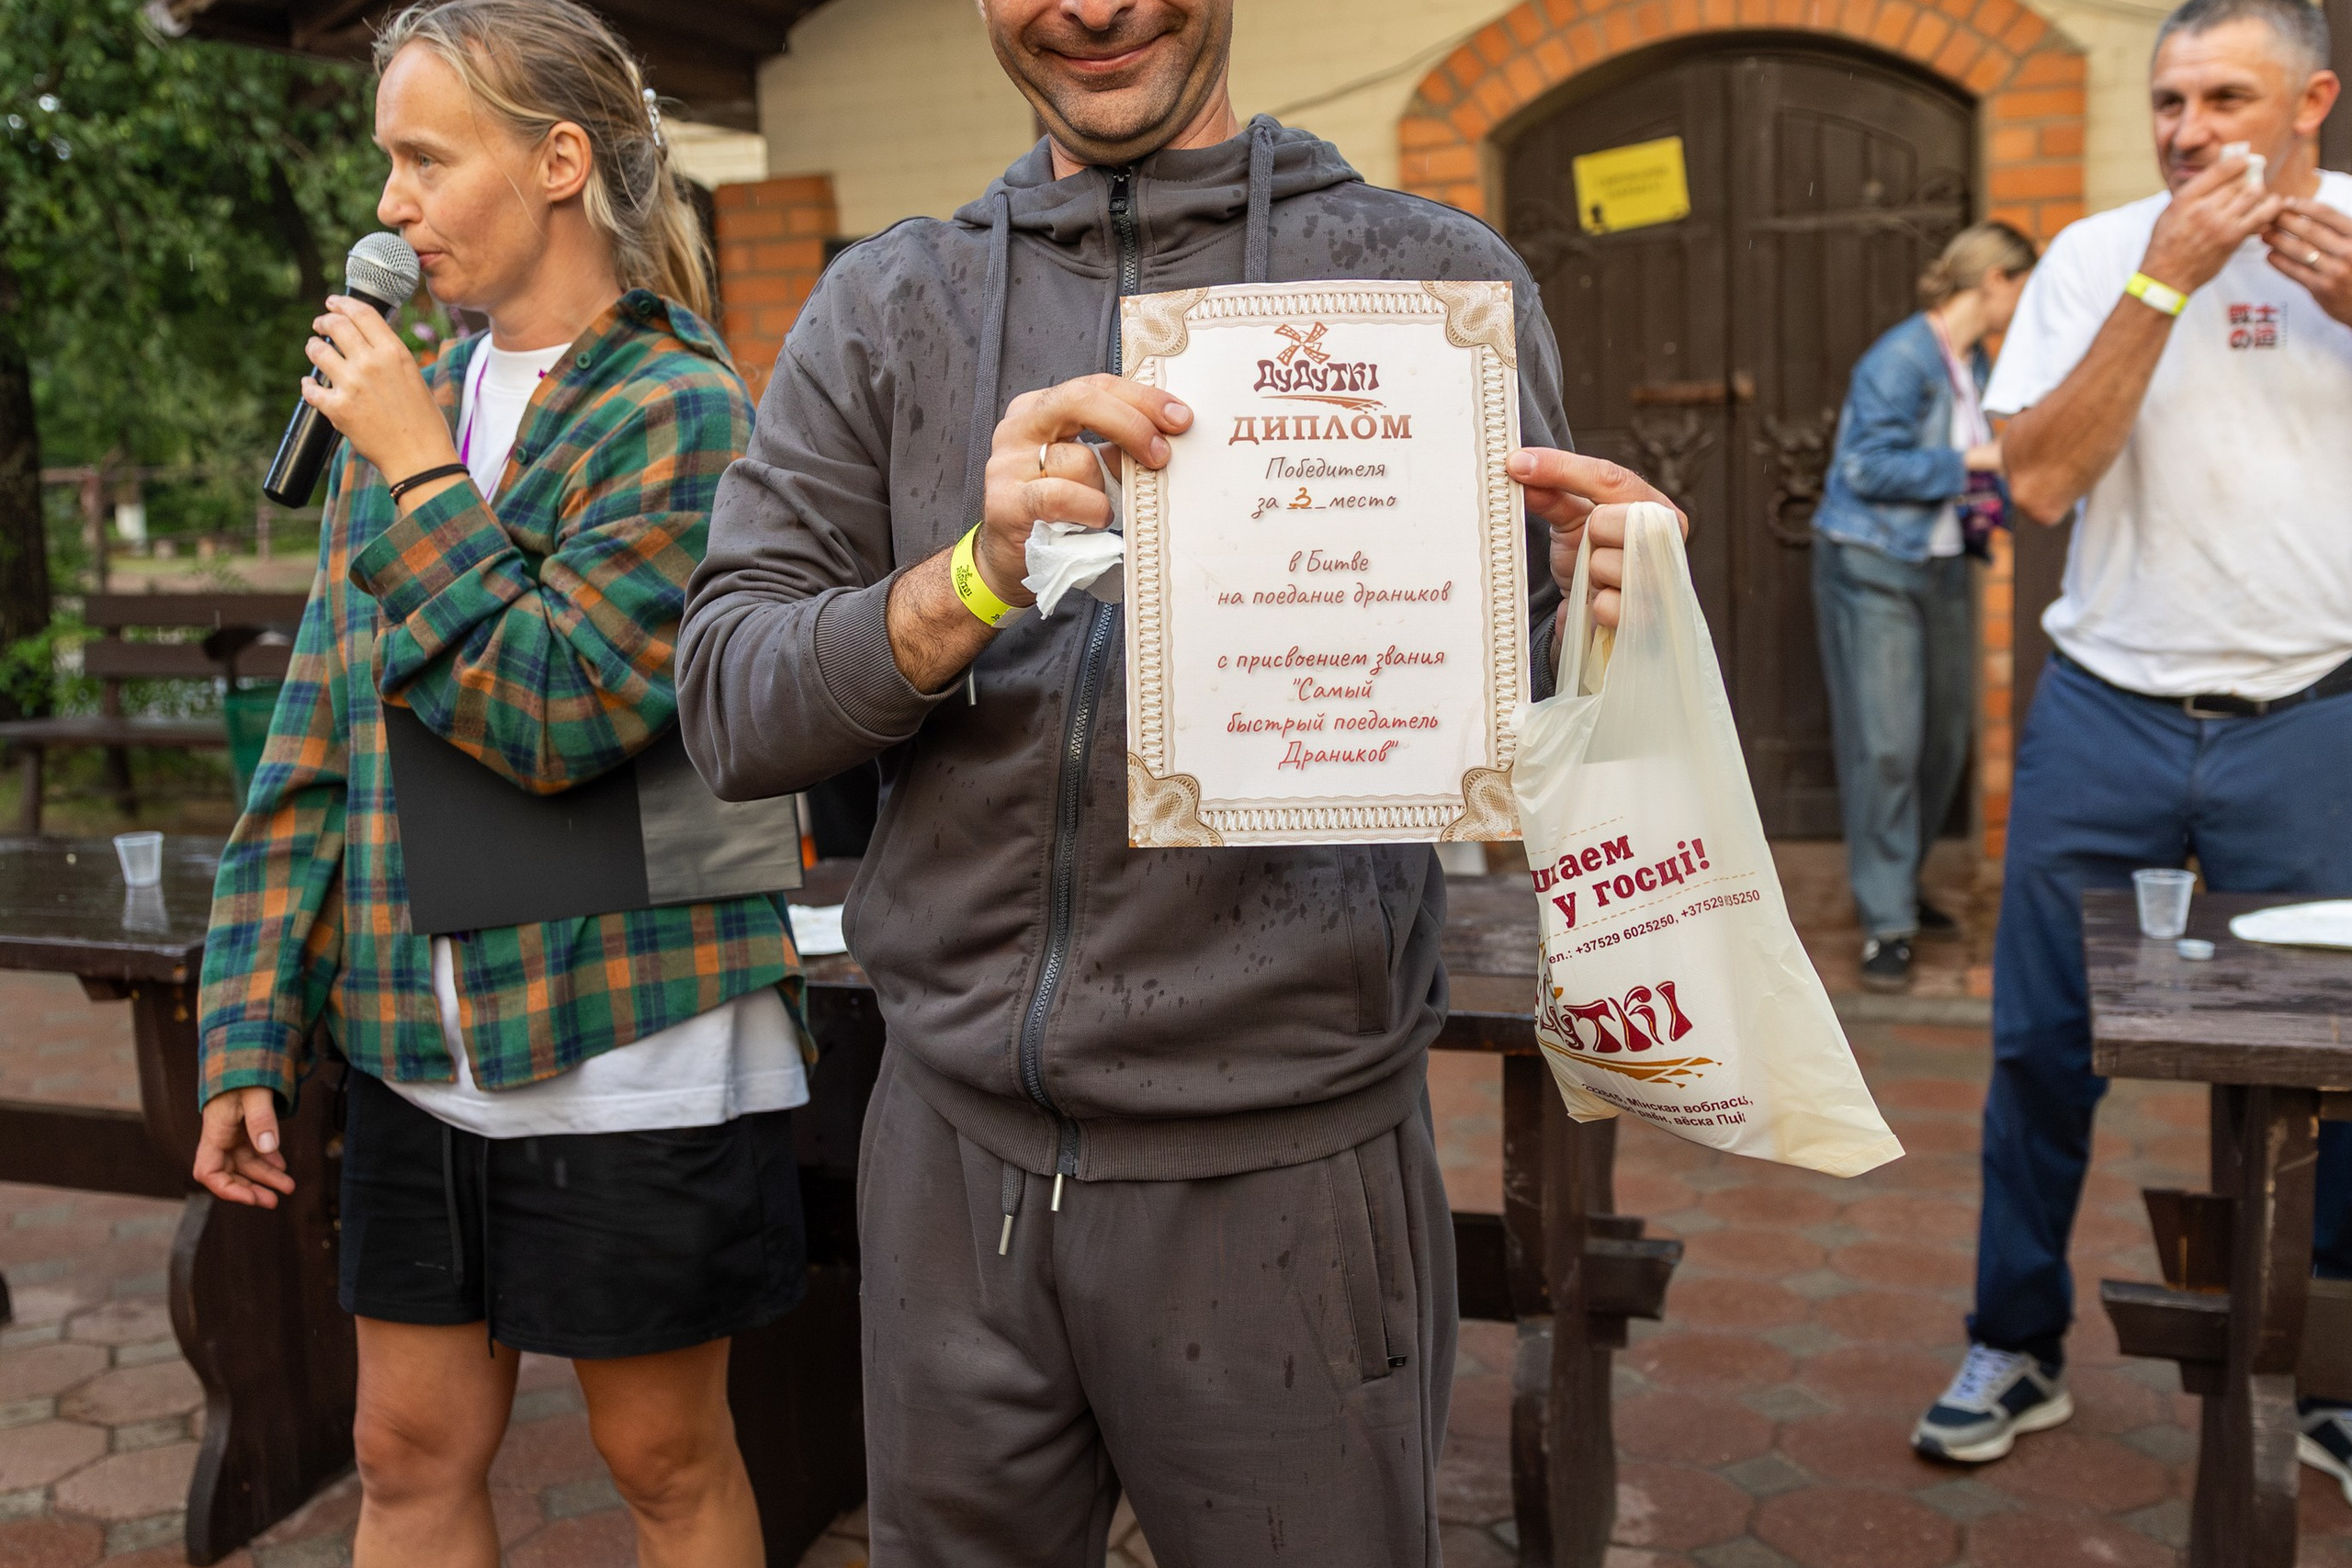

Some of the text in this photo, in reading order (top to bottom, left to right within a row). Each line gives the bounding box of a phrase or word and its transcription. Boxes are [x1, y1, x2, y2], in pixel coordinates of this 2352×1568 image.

[1228, 413, 1413, 446] ДИПЛОМ
[1265, 457, 1386, 479] Победителя
[1251, 497, 1280, 520] за
[1329, 495, 1397, 509] место
[1289, 549, 1370, 572] в Битве
[1218, 581, 1452, 609] на поедание драников
[1217, 645, 1445, 676] с присвоением звания
[1293, 677, 1374, 702] "Самый
[1227, 710, 1439, 739] быстрый поедатель
[1277, 739, 1399, 771] Драников"
[1552, 837, 1711, 929] у госці!
[1575, 932, 1622, 954] +37529
[1623, 913, 1680, 941] 6025250,
[1626, 1097, 1681, 1113] Мінская
